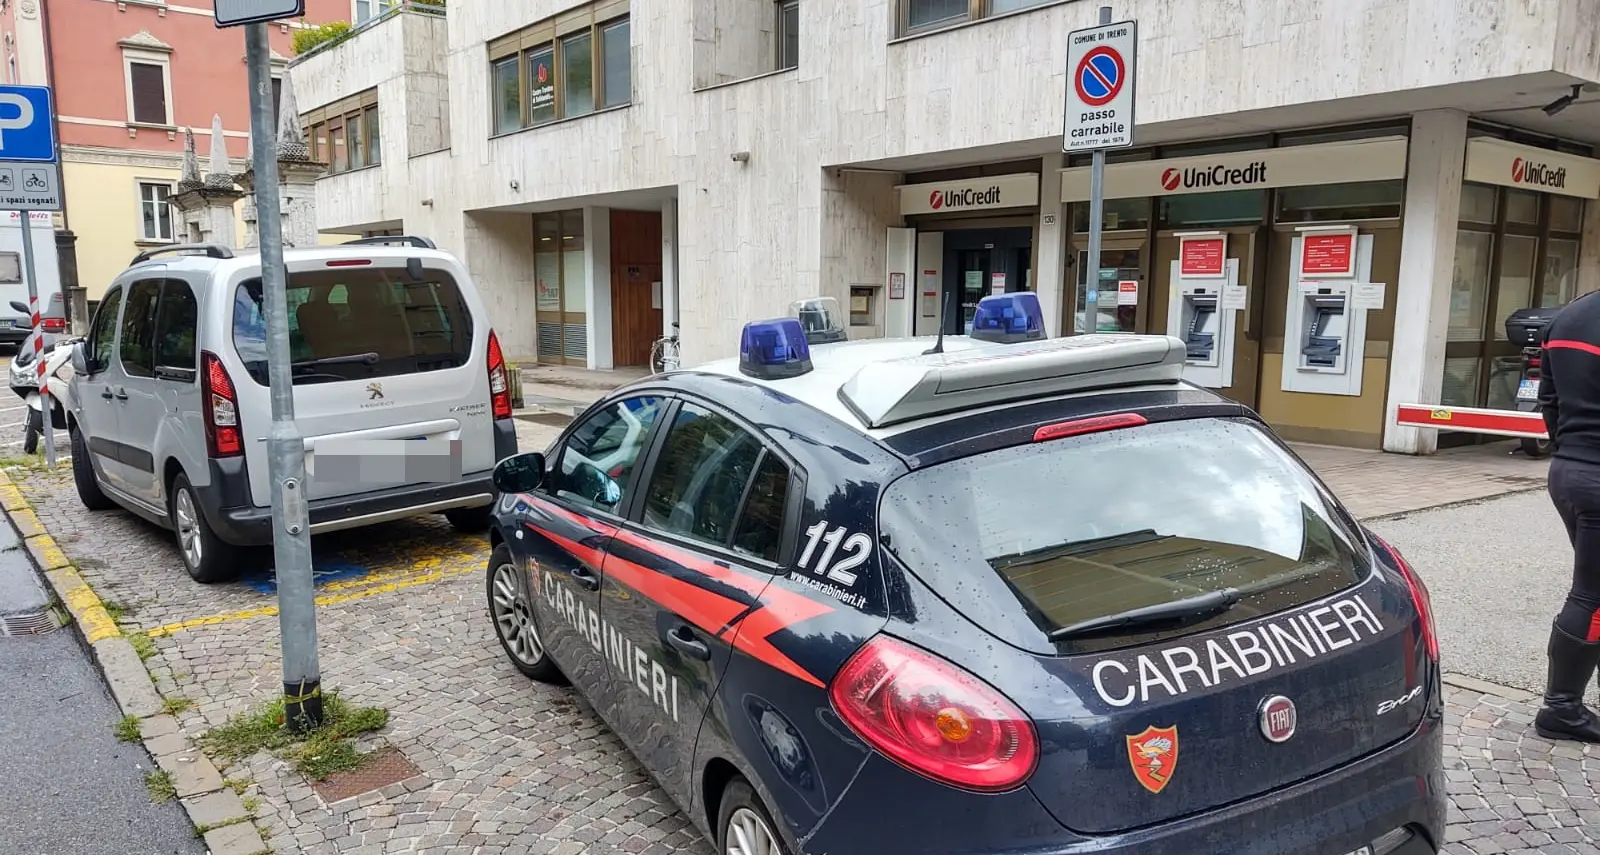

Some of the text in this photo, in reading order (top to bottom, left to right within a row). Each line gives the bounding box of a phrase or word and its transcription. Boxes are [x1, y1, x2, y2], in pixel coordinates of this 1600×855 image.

[1074, 28, 1128, 45] COMUNE DI TRENTO
[0, 93, 34, 150] P
[1071, 122, 1125, 138] carrabile
[1080, 109, 1115, 123] passo
[1184, 161, 1267, 188] UniCredit
[1524, 159, 1566, 189] UniCredit
[6, 196, 26, 205] spazi
[28, 197, 56, 205] segnati
[945, 186, 1001, 207] UniCredit
[797, 520, 874, 587] 112
[789, 570, 866, 610] www.carabinieri.it
[543, 571, 680, 723] CARABINIERI
[1092, 594, 1385, 707] CARABINIERI
[1270, 707, 1293, 735] FIAT
